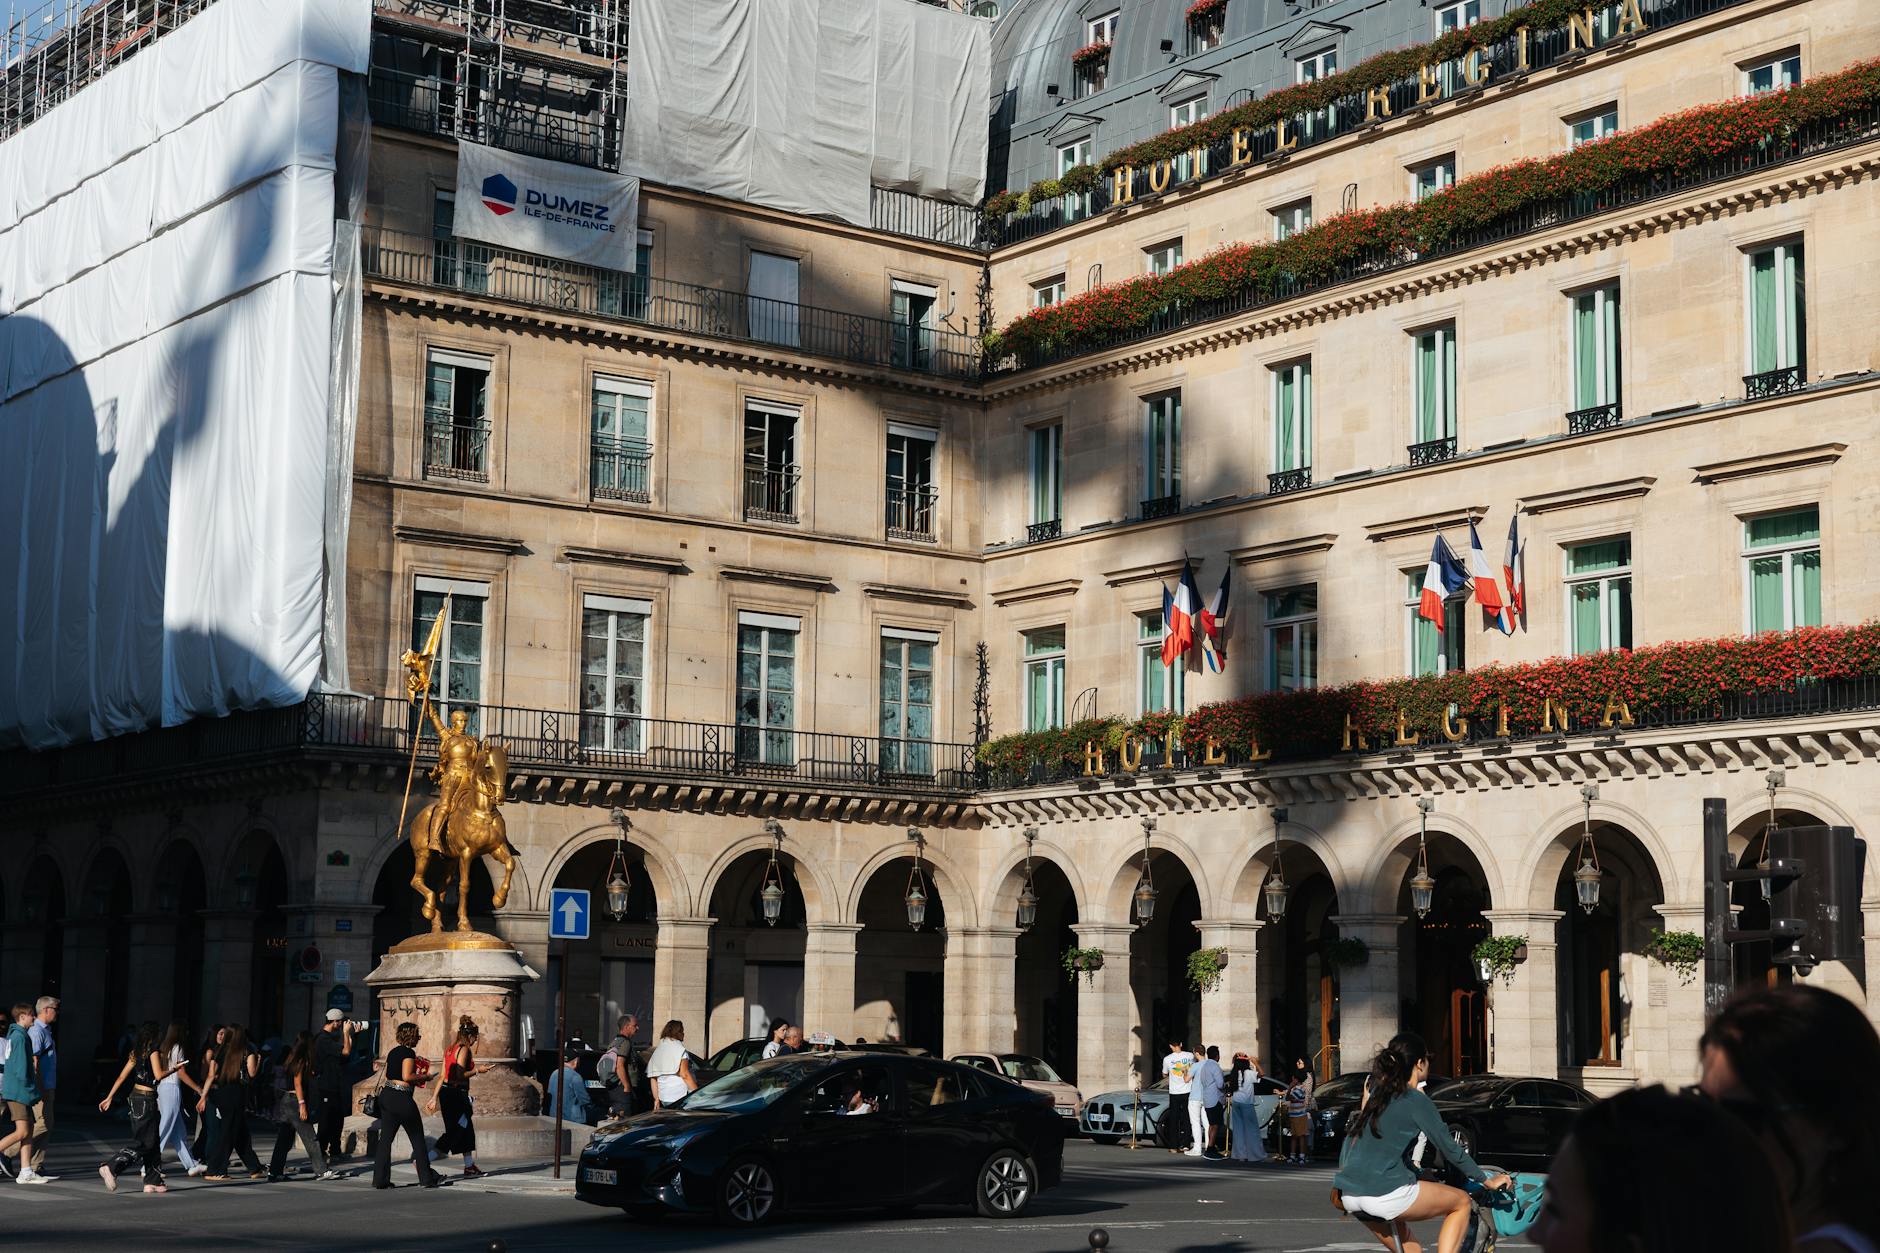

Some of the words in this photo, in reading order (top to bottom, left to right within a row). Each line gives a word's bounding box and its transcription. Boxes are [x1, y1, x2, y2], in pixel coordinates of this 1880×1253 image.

[1112, 117, 1298, 205] HOTEL
[1364, 0, 1648, 121] REGINA
[526, 189, 609, 221] DUMEZ
